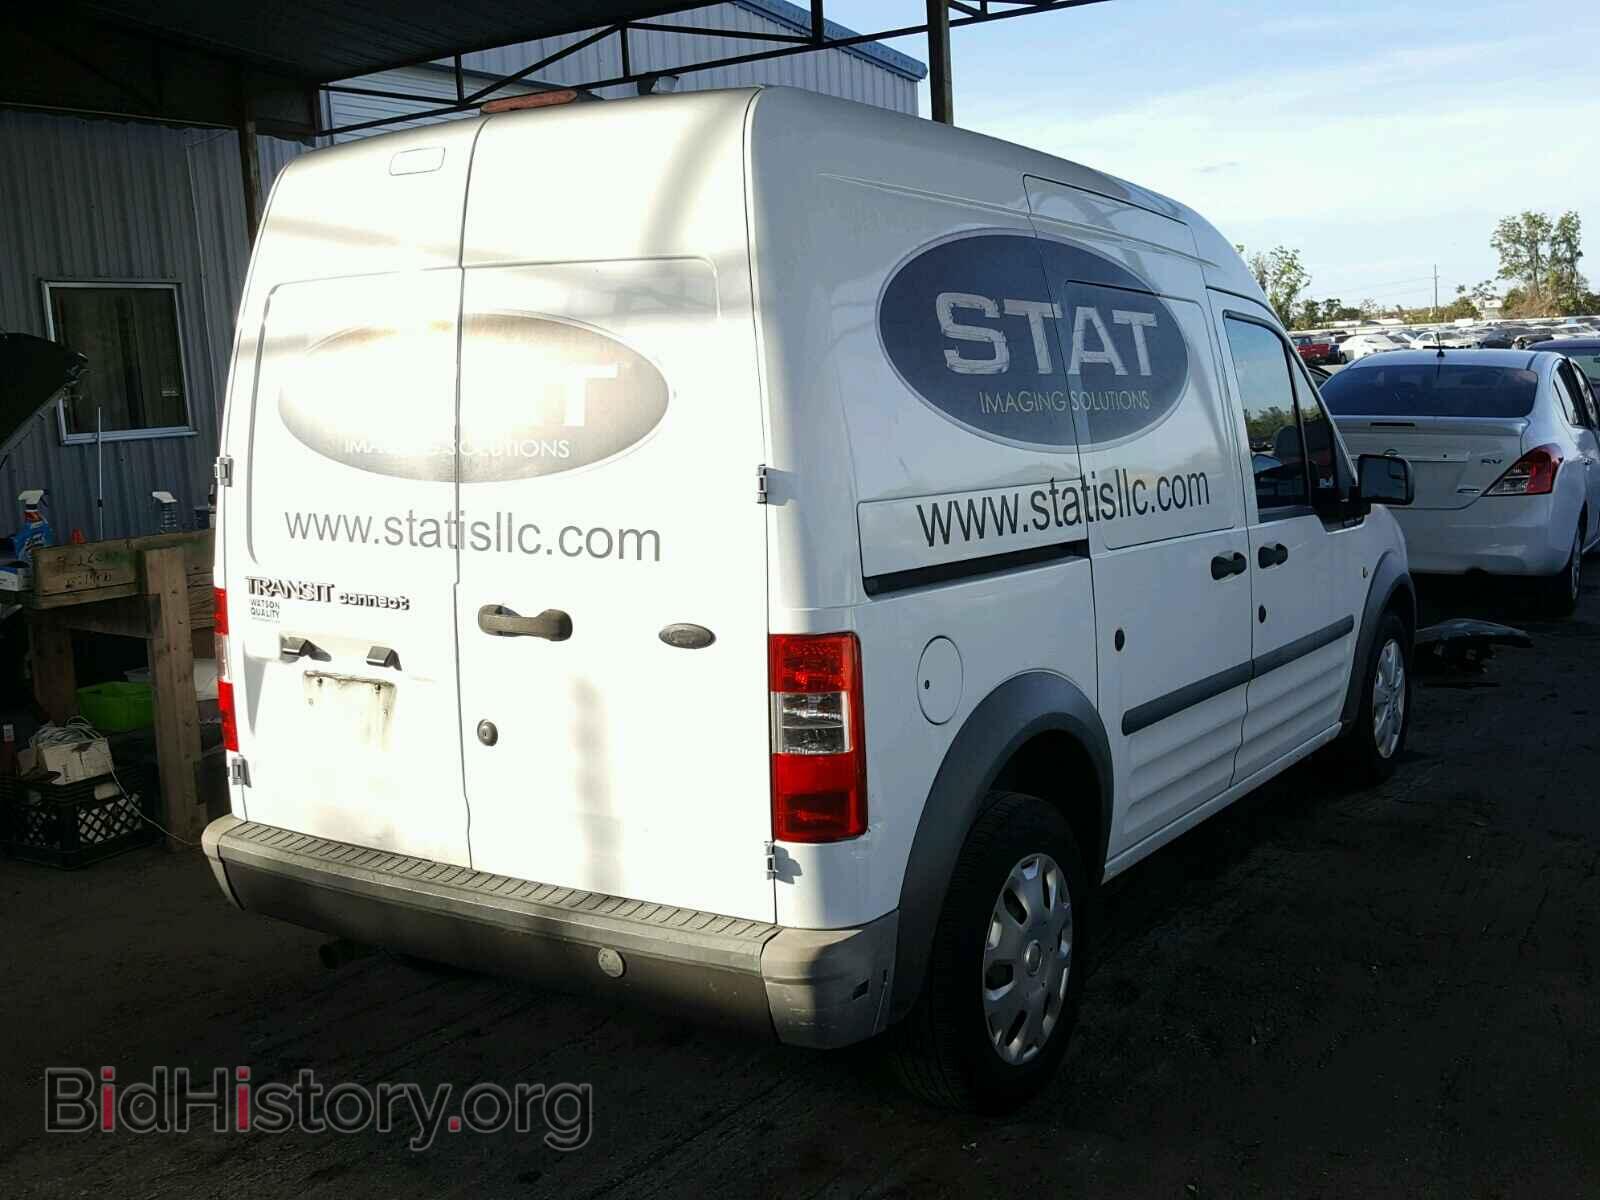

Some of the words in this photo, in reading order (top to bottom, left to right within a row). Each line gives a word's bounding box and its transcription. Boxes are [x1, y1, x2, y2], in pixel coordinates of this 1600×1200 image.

[935, 291, 1158, 376] STAT
[979, 391, 1067, 415] IMAGING
[1070, 390, 1151, 411] SOLUTIONS
[917, 468, 1210, 548] www.statisllc.com
[284, 509, 661, 562] www.statisllc.com
[245, 575, 336, 603] TRANSIT
[250, 599, 281, 609] WATSON
[250, 607, 281, 619] QUALITY
